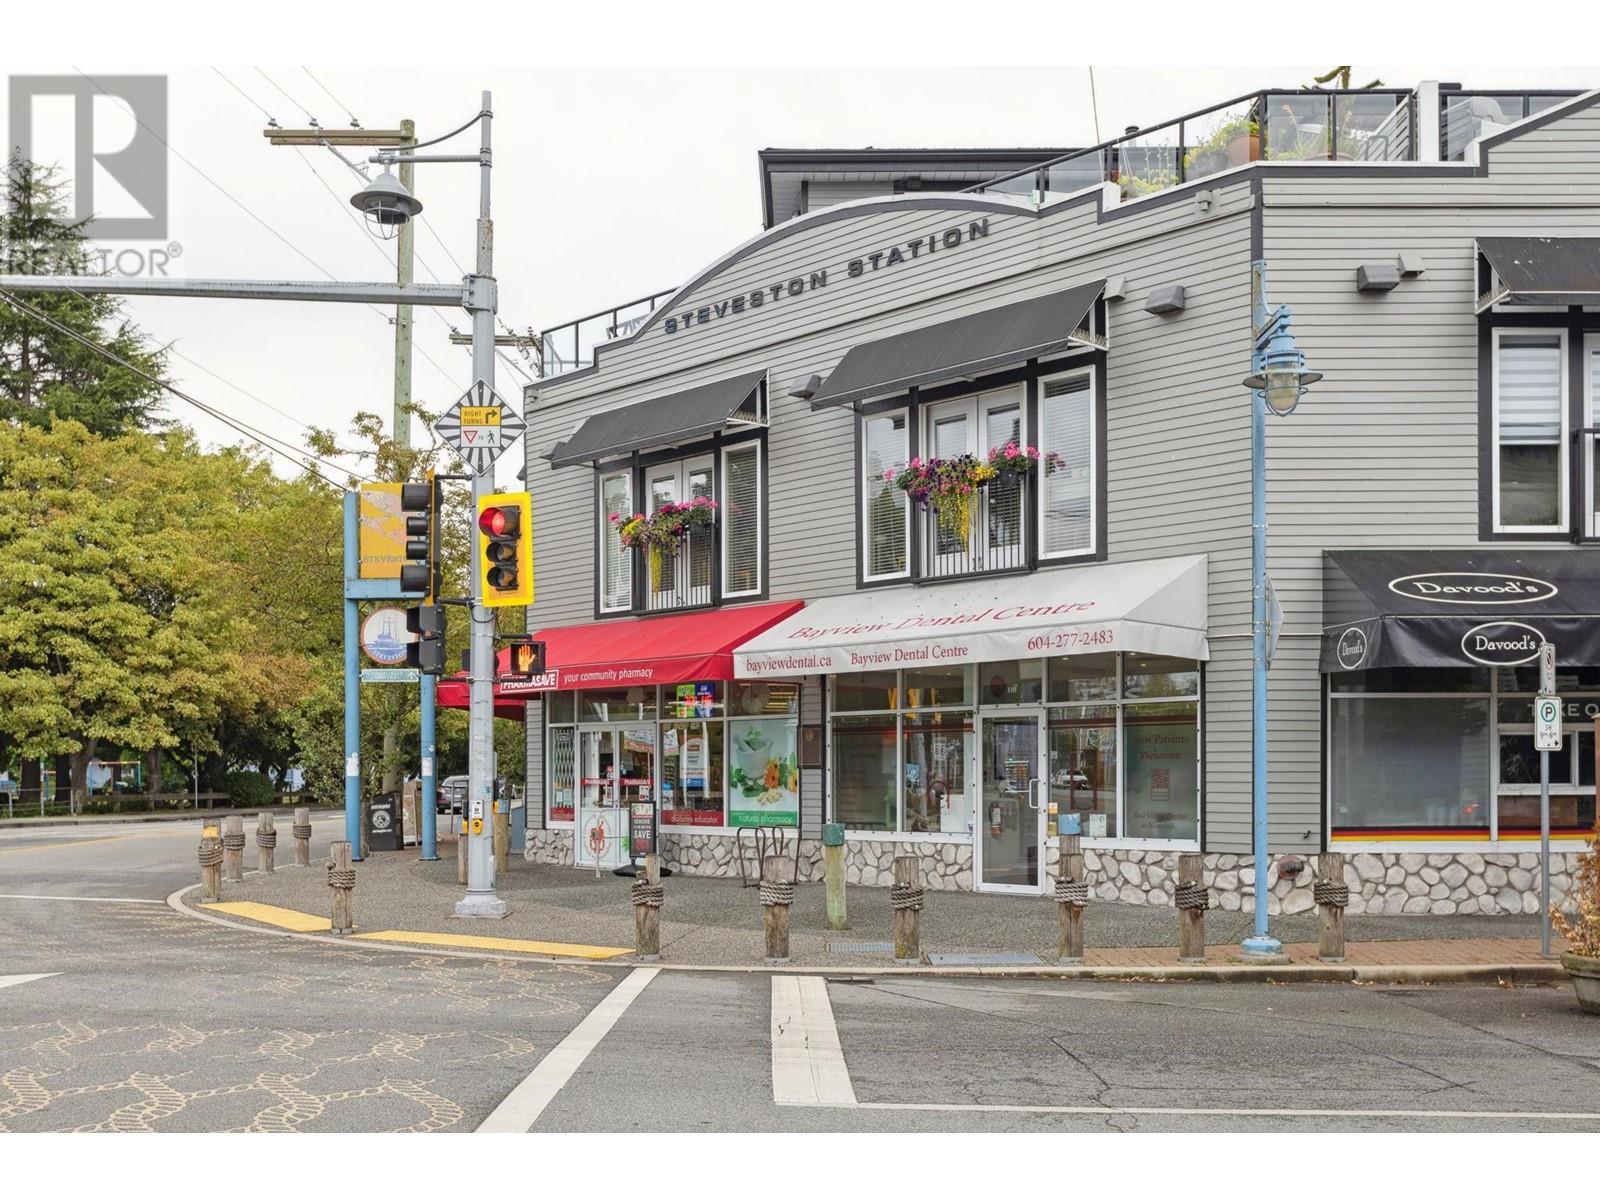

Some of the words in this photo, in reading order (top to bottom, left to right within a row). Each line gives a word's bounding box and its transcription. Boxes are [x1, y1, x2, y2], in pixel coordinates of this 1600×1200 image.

[664, 269, 828, 335] STEVESTON
[848, 217, 990, 279] STATION
[1412, 581, 1539, 594] Davood's
[787, 622, 893, 641] Bayview
[895, 608, 990, 631] Dental
[993, 601, 1096, 620] Centre
[1341, 641, 1364, 657] Davood's
[1475, 635, 1536, 651] Davood's
[745, 653, 832, 674] bayviewdental.ca
[850, 650, 893, 666] Bayview
[894, 646, 930, 662] Dental
[932, 644, 969, 659] Centre
[1027, 629, 1114, 651] 604-277-2483
[563, 673, 579, 685] your
[580, 668, 618, 681] community
[618, 667, 653, 680] pharmacy
[1527, 703, 1580, 717] TE
[1545, 706, 1553, 718] P
[1140, 750, 1184, 760] Welcome
[694, 815, 718, 823] educator
[760, 815, 793, 824] pharmacy
[633, 829, 652, 839] SAVE
